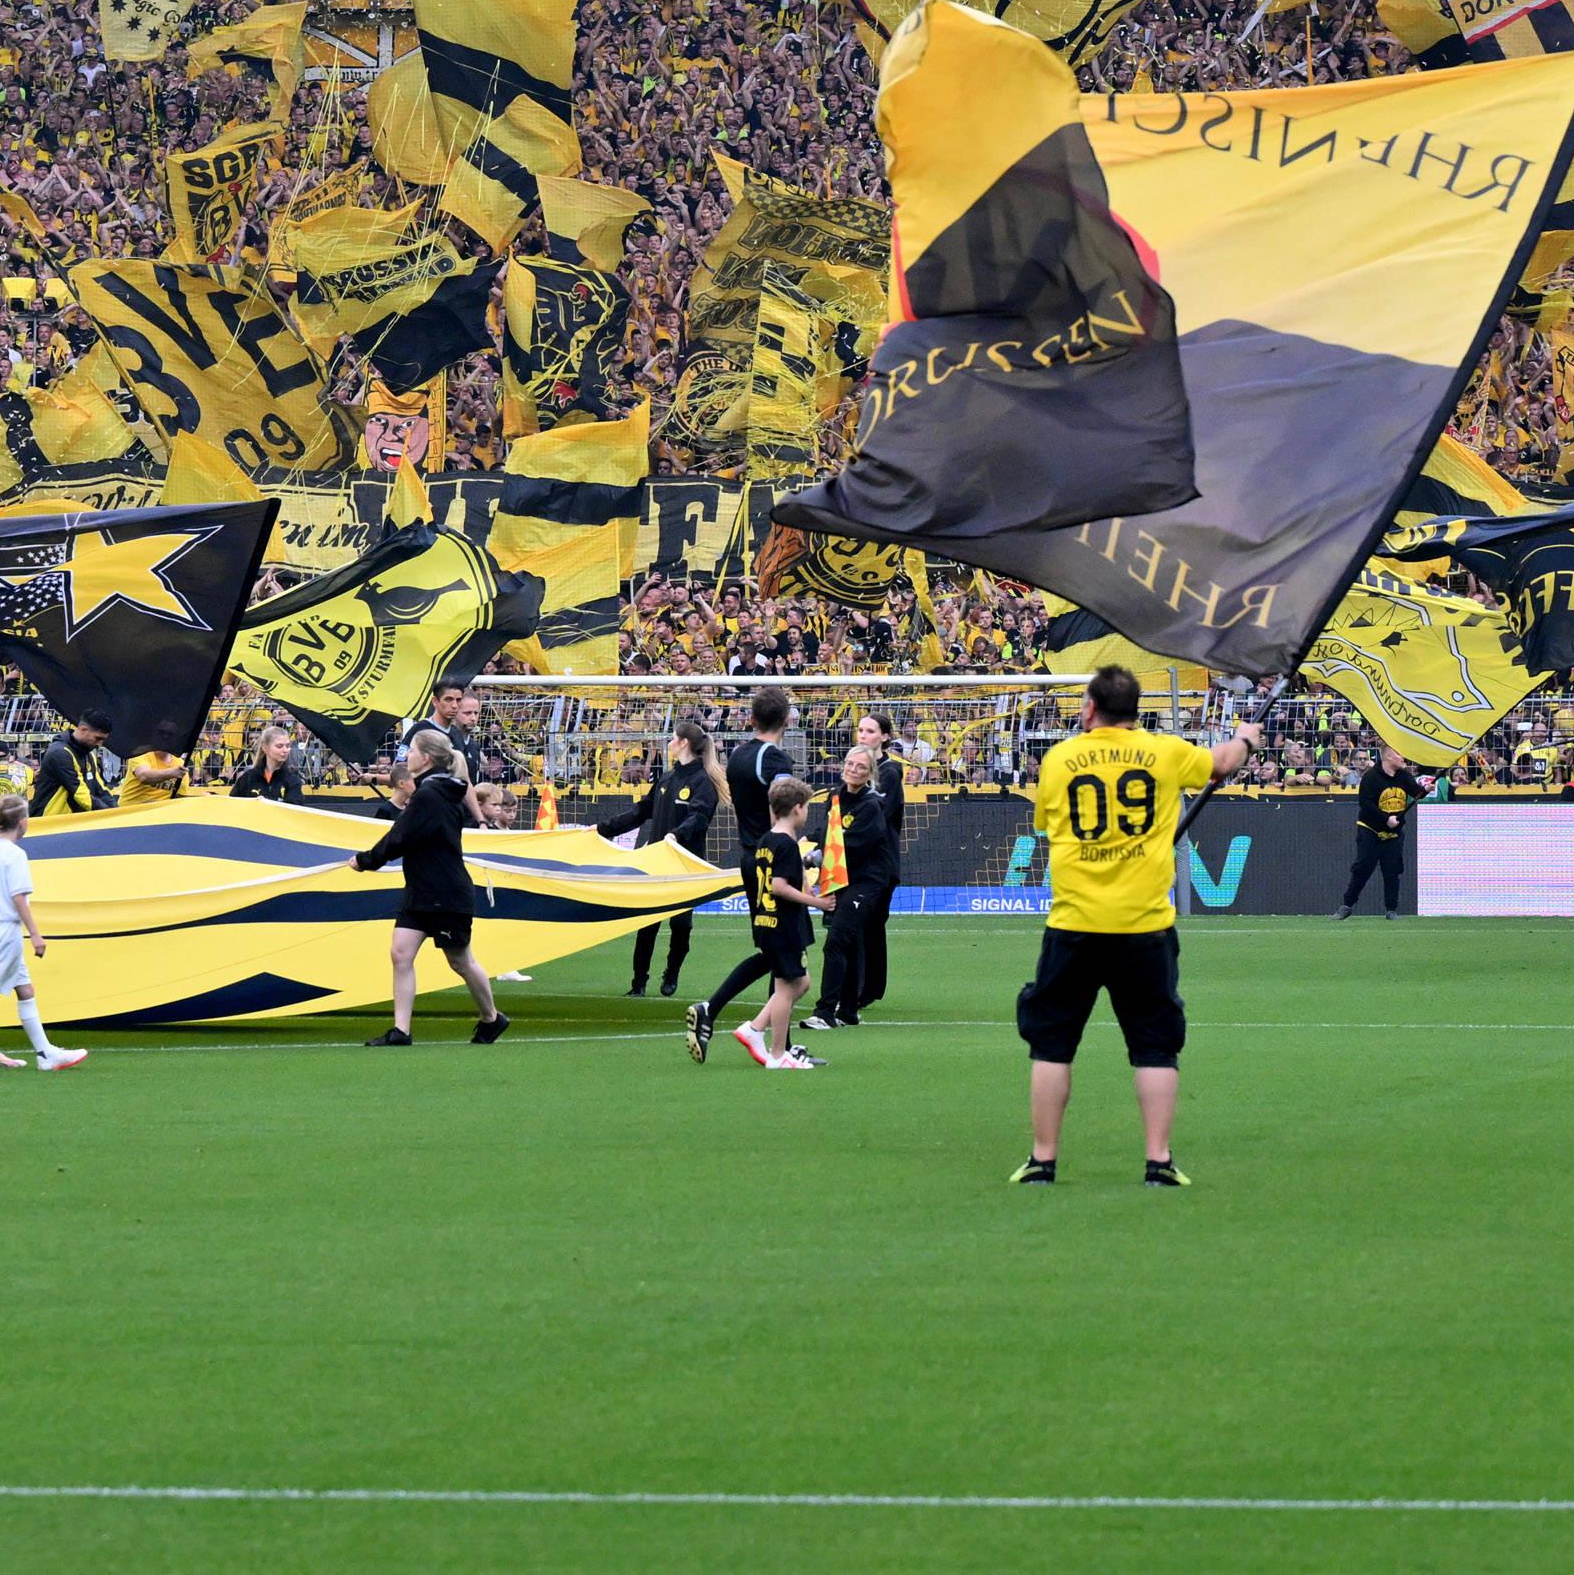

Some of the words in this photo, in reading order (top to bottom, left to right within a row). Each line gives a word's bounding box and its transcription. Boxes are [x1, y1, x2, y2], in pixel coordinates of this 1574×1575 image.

[689, 356, 725, 374] THE
[224, 413, 307, 475] 09
[287, 618, 357, 683] BVB
[333, 649, 352, 673] 09
[1064, 746, 1157, 776] DORTMUND
[1067, 770, 1156, 841] 09
[1079, 840, 1147, 863] BORUSSIA
[722, 898, 750, 911] SIG
[971, 898, 1034, 911] SIGNAL
